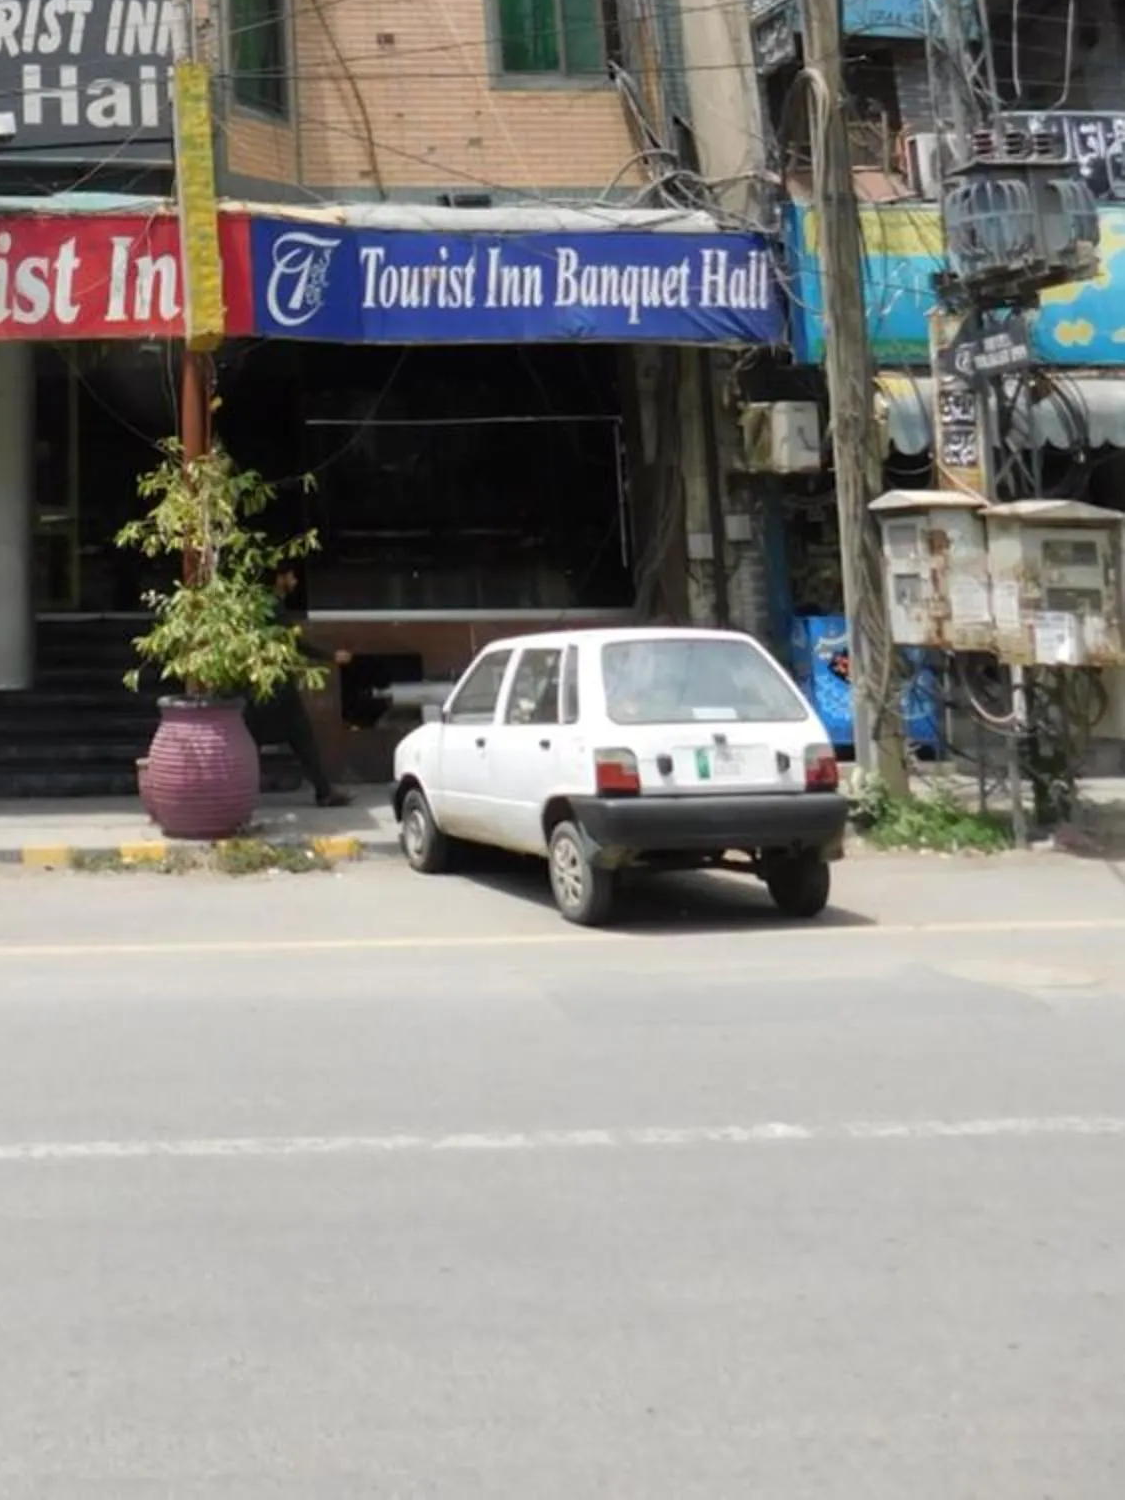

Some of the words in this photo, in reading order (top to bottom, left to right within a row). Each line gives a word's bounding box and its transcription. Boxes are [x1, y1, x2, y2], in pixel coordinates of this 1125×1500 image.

[104, 236, 186, 321] In
[359, 246, 476, 308] Tourist
[484, 247, 544, 308] Inn
[554, 247, 691, 325] Banquet
[699, 249, 769, 310] Hall
